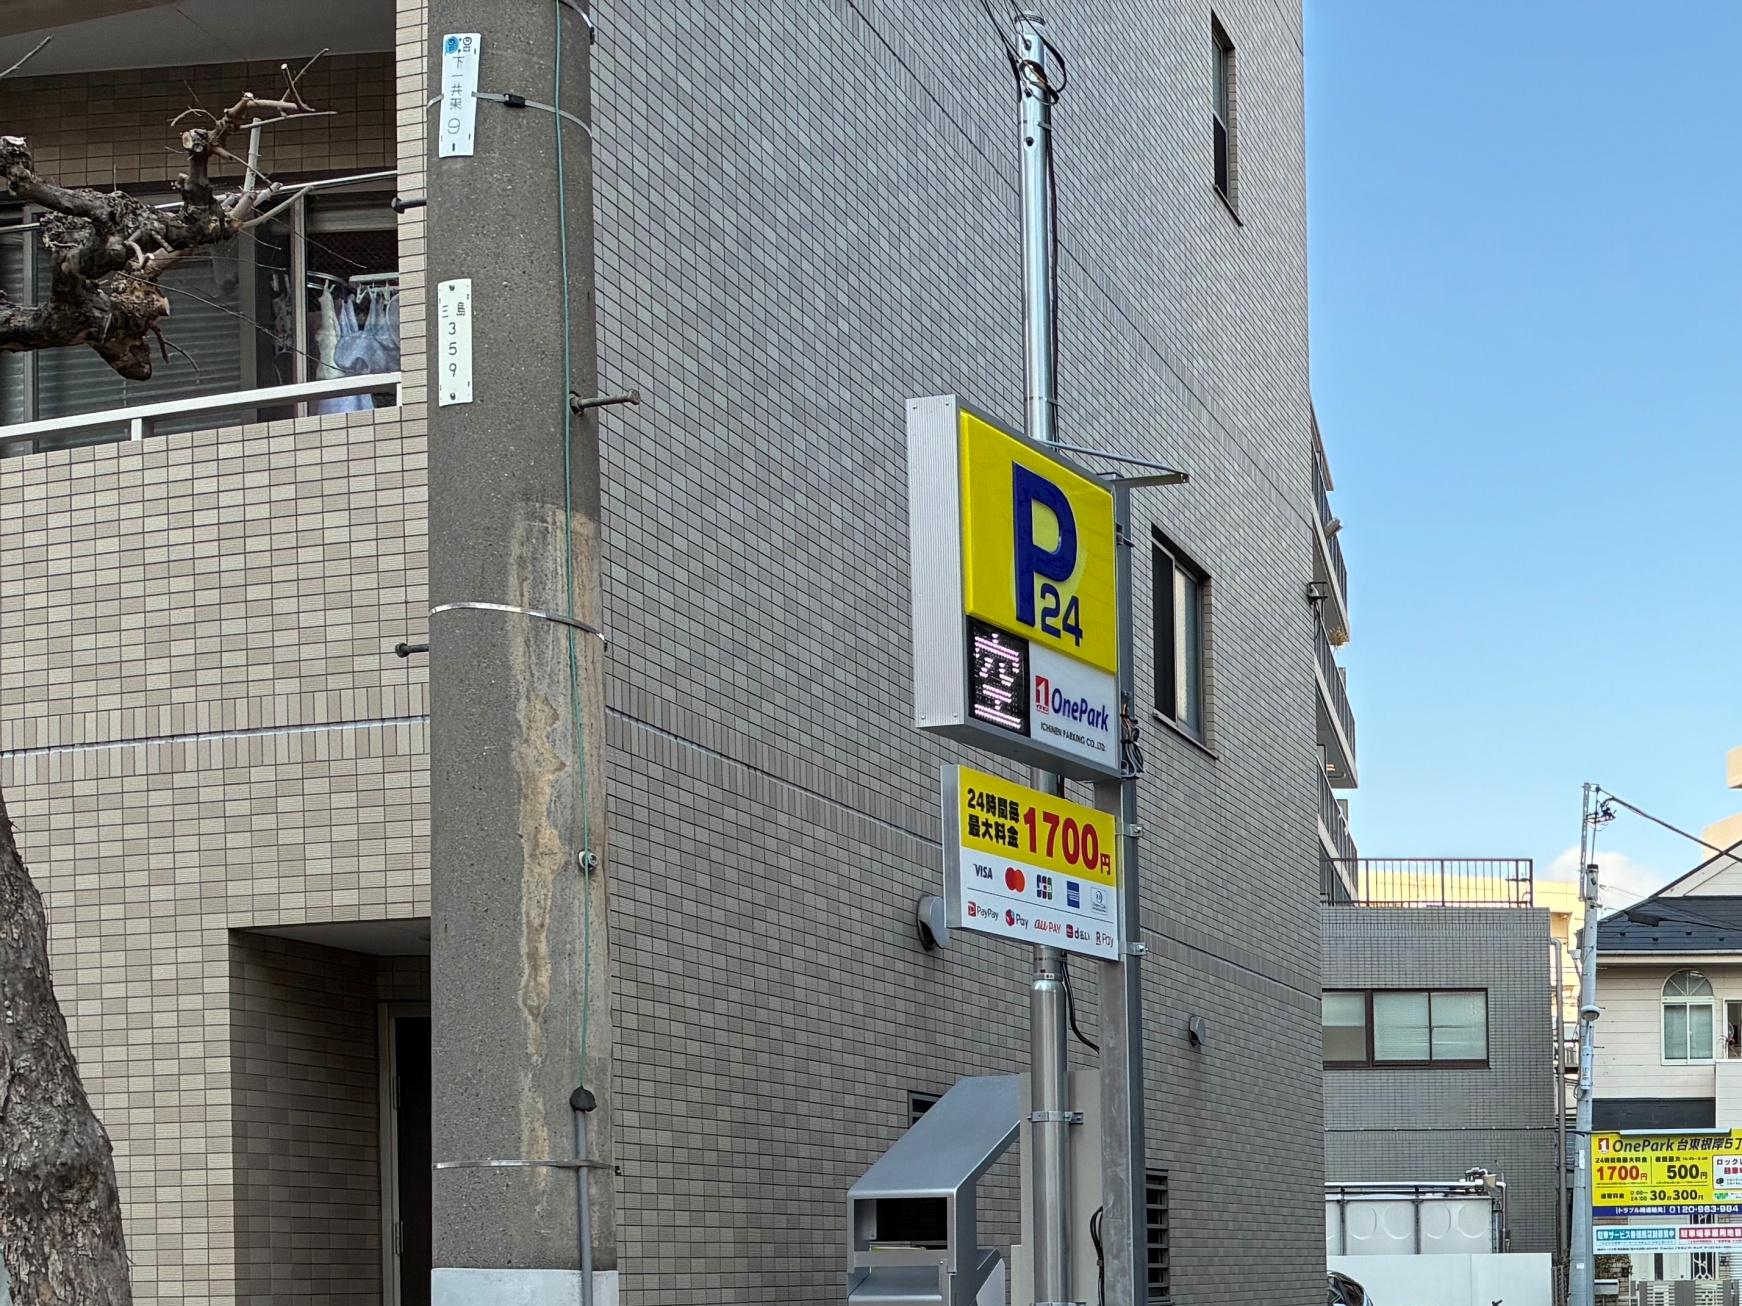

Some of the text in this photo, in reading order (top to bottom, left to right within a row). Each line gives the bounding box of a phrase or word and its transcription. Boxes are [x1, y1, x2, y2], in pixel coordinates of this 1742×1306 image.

[1012, 461, 1083, 647] P 24
[974, 634, 1021, 729] 空
[1052, 688, 1109, 732] OnePark
[1040, 722, 1062, 737] ICHINEN
[1063, 730, 1086, 745] PARKING
[967, 788, 1019, 823] 24時間毎
[968, 813, 1019, 848] 最大料金
[973, 864, 993, 880] VISA
[977, 906, 999, 921] PayPay
[1016, 914, 1028, 929] Pay
[1613, 1138, 1674, 1152] OnePark
